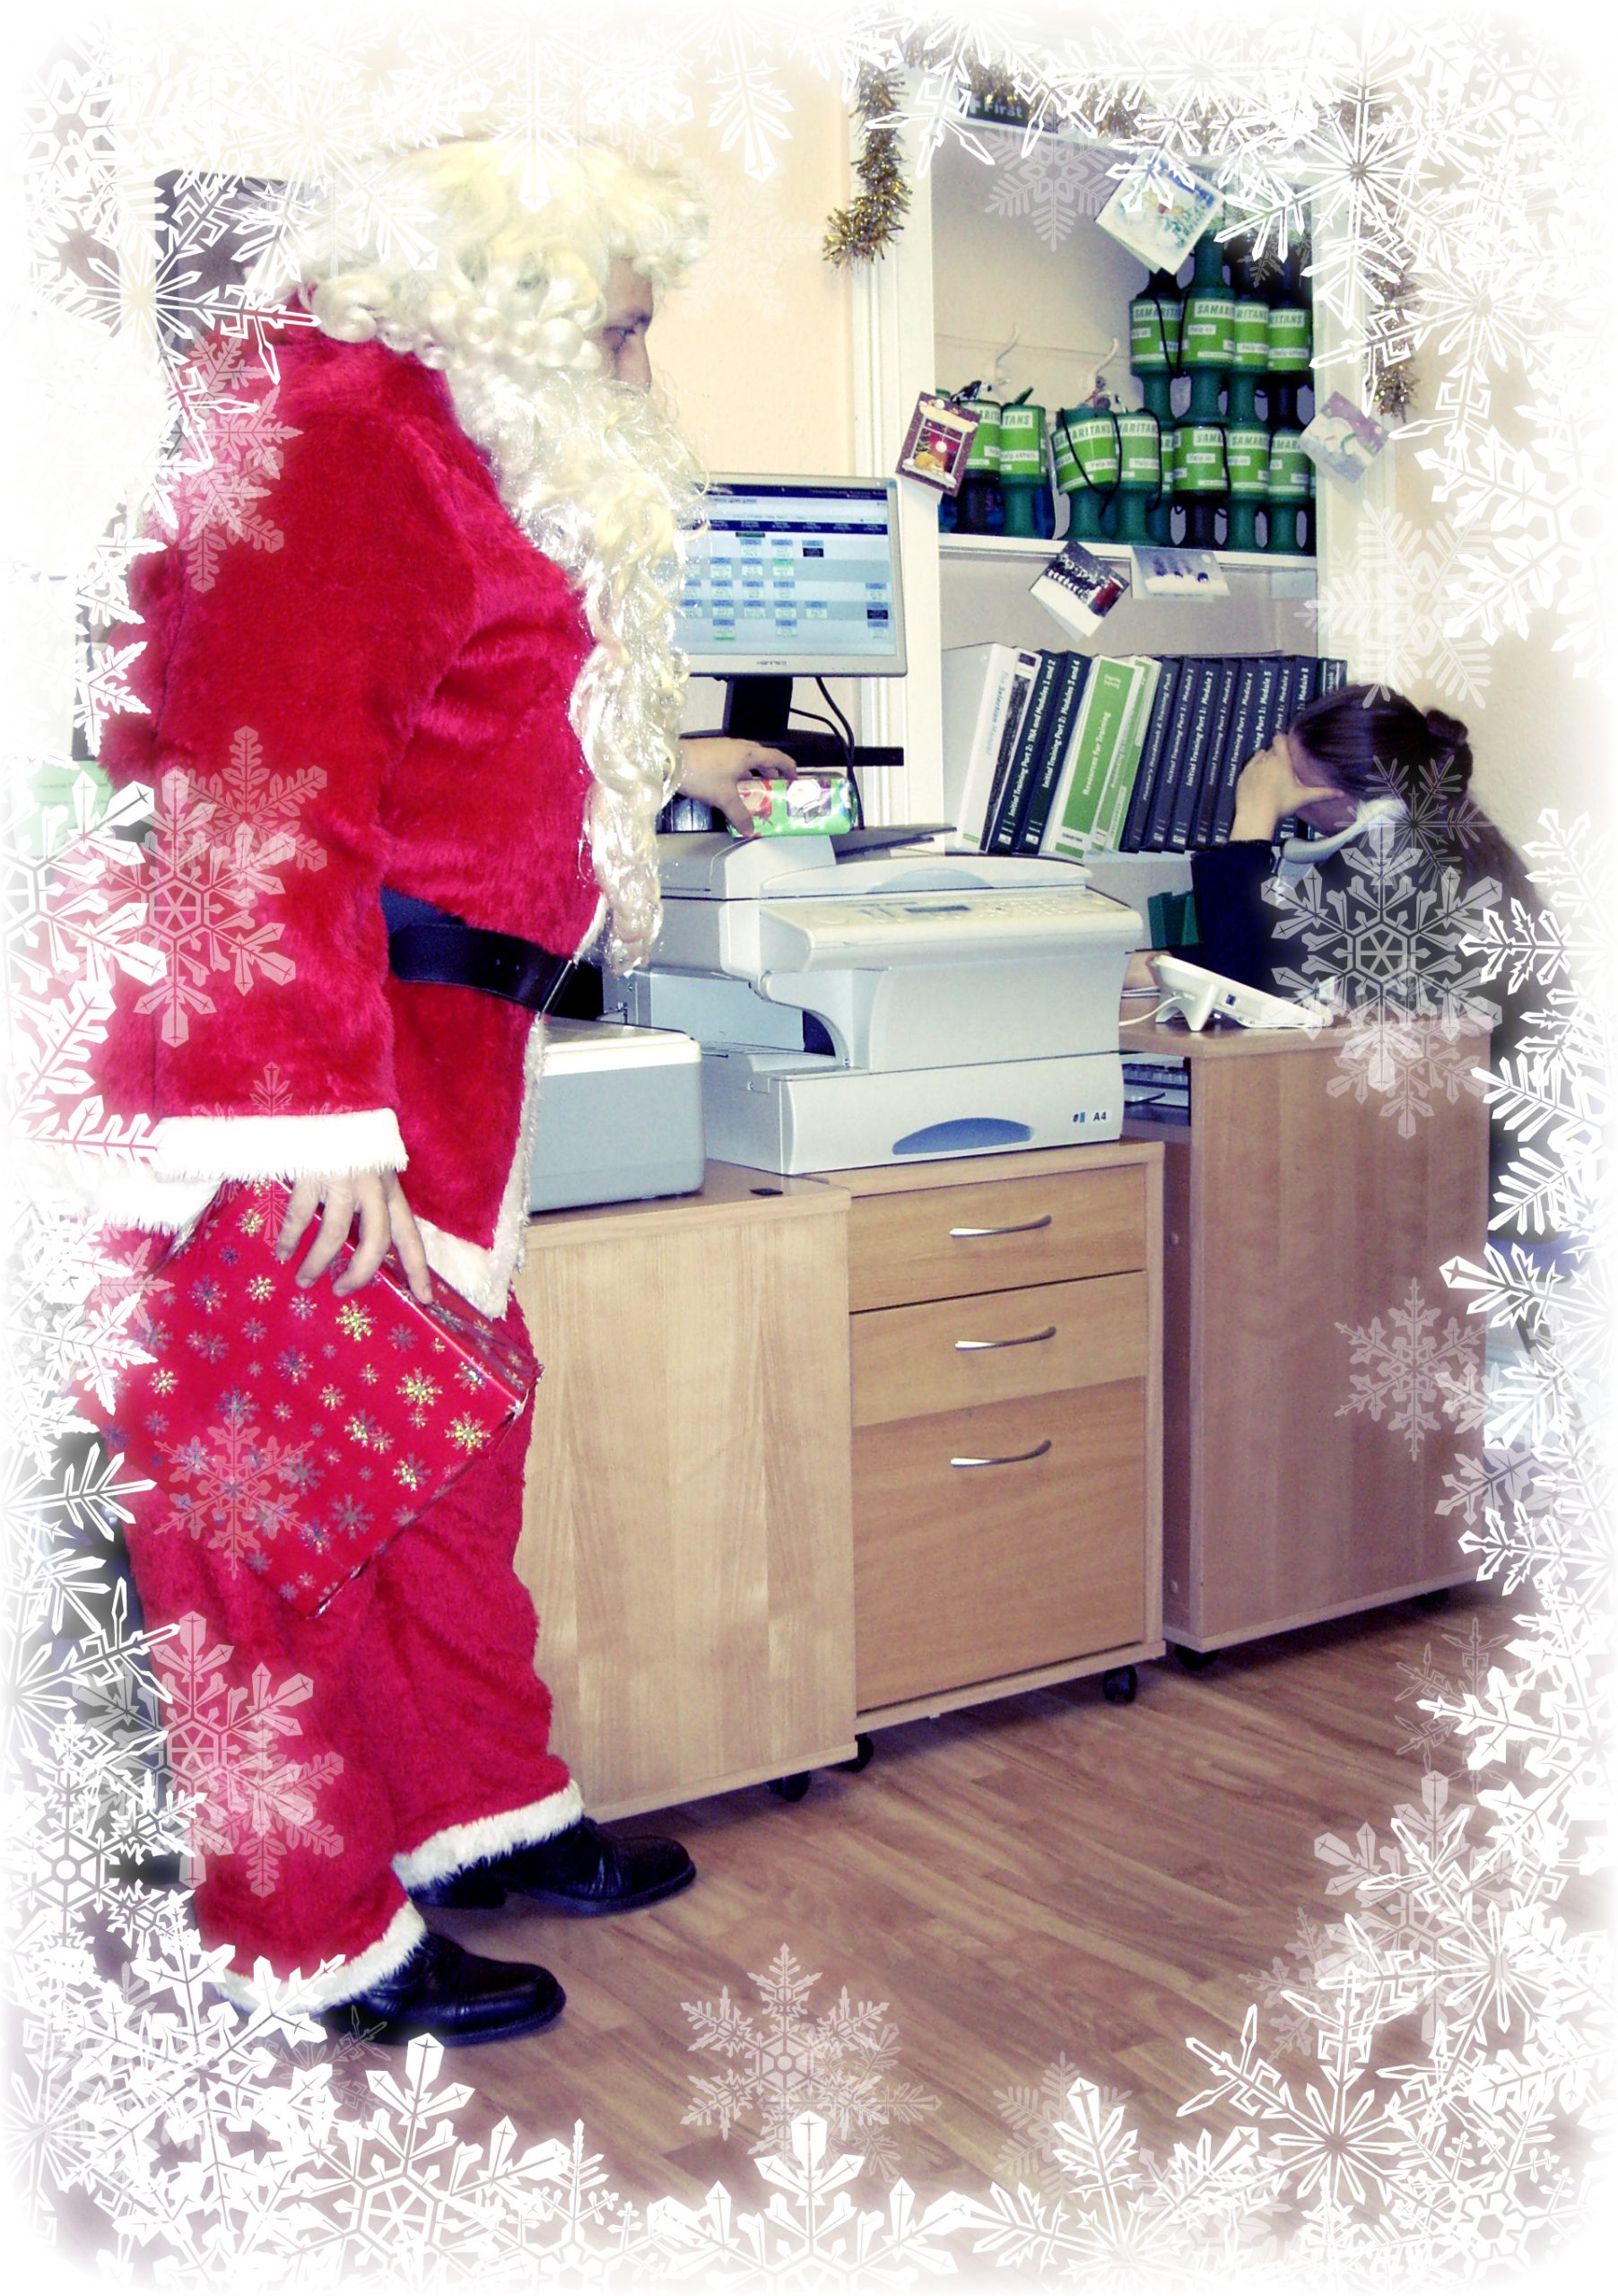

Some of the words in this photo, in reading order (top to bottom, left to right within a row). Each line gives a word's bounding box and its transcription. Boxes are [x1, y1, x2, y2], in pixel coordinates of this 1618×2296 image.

[1183, 675, 1192, 701] Module
[1202, 678, 1212, 704] Module
[1242, 680, 1251, 705] Module
[1260, 678, 1270, 704] Module
[1299, 674, 1308, 700] Module
[1036, 687, 1048, 714] Modules
[1275, 714, 1283, 729] Part
[1280, 676, 1288, 702] Module
[1033, 714, 1041, 728] and
[1196, 716, 1205, 732] Part
[1213, 733, 1223, 761] Training
[1222, 678, 1231, 704] Module
[1237, 718, 1245, 732] Part
[1256, 716, 1265, 731] Part
[1028, 729, 1037, 742] TNA
[1043, 767, 1053, 787] Initial
[1048, 740, 1062, 766] Training
[1055, 725, 1064, 739] Part
[1061, 687, 1074, 714] Modules
[1171, 730, 1183, 759] Training
[1190, 733, 1204, 761] Training
[1231, 734, 1243, 762] Training
[1022, 752, 1031, 767] Part
[1083, 757, 1098, 795] Resources
[1092, 744, 1100, 755] for
[1096, 712, 1111, 742] Training
[1014, 768, 1029, 795] Training
[1167, 761, 1176, 783] Initial
[1187, 763, 1196, 786] Initial
[1228, 764, 1236, 787] Initial
[1009, 796, 1019, 816] Initial
[1093, 1111, 1107, 1121] A4
